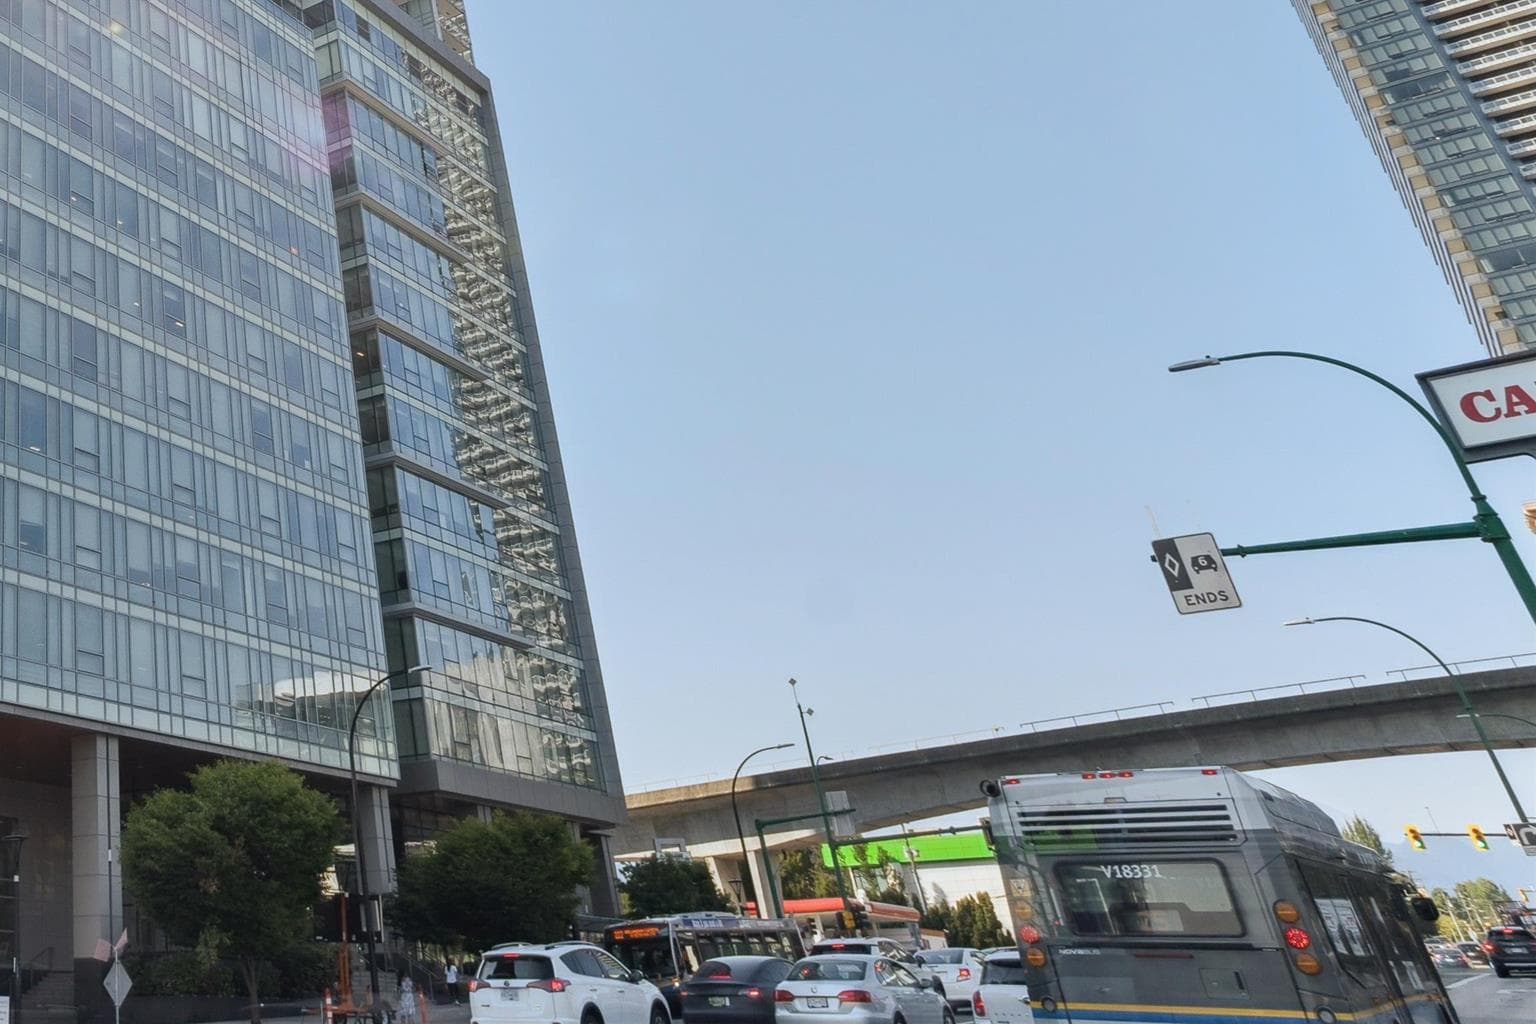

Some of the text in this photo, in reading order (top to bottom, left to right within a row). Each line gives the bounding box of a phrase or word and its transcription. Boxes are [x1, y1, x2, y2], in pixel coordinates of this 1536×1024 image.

[1460, 382, 1536, 423] CA
[1198, 556, 1208, 567] 6
[1184, 590, 1229, 606] ENDS
[1100, 864, 1164, 880] V18331
